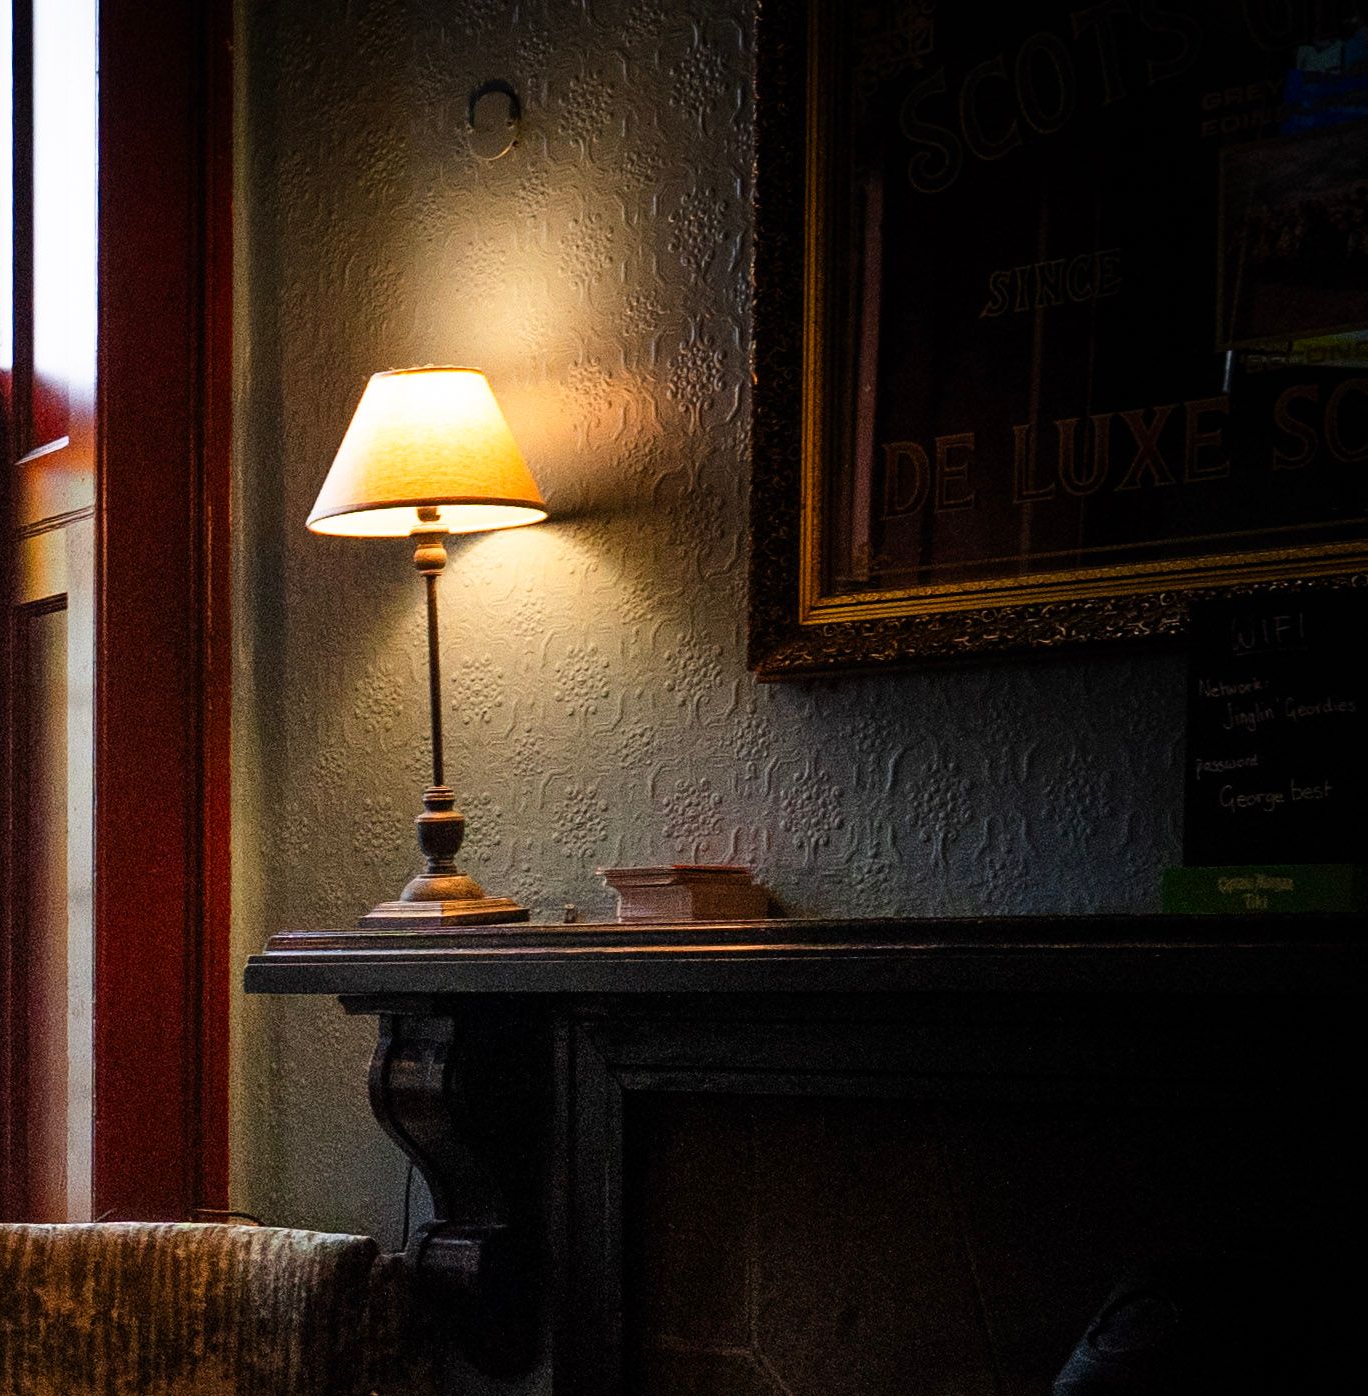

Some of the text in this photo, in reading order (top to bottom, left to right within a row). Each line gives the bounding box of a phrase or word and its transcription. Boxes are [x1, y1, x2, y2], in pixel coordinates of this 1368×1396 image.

[979, 249, 1122, 319] SINCE
[880, 432, 976, 521] DE
[1012, 394, 1232, 504] LUXE
[1231, 612, 1305, 651] WIFI
[1284, 697, 1357, 722] Geordies
[1219, 778, 1334, 813] George best
